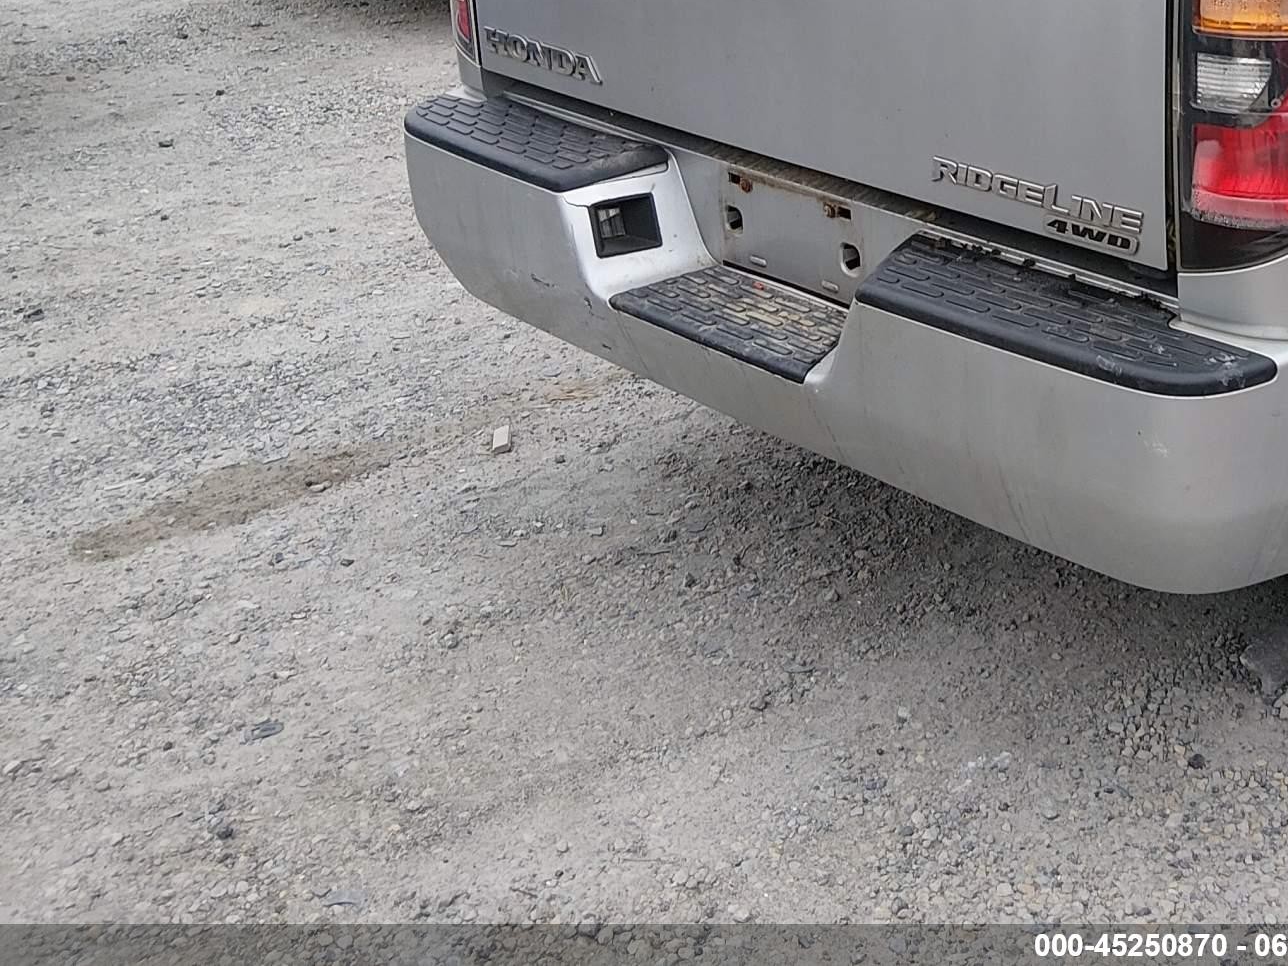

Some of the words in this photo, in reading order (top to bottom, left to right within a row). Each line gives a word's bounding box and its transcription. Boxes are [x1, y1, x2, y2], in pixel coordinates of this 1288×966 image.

[484, 25, 602, 85] HONDA
[931, 155, 1144, 234] RIDGELINE
[1047, 218, 1132, 250] 4WD
